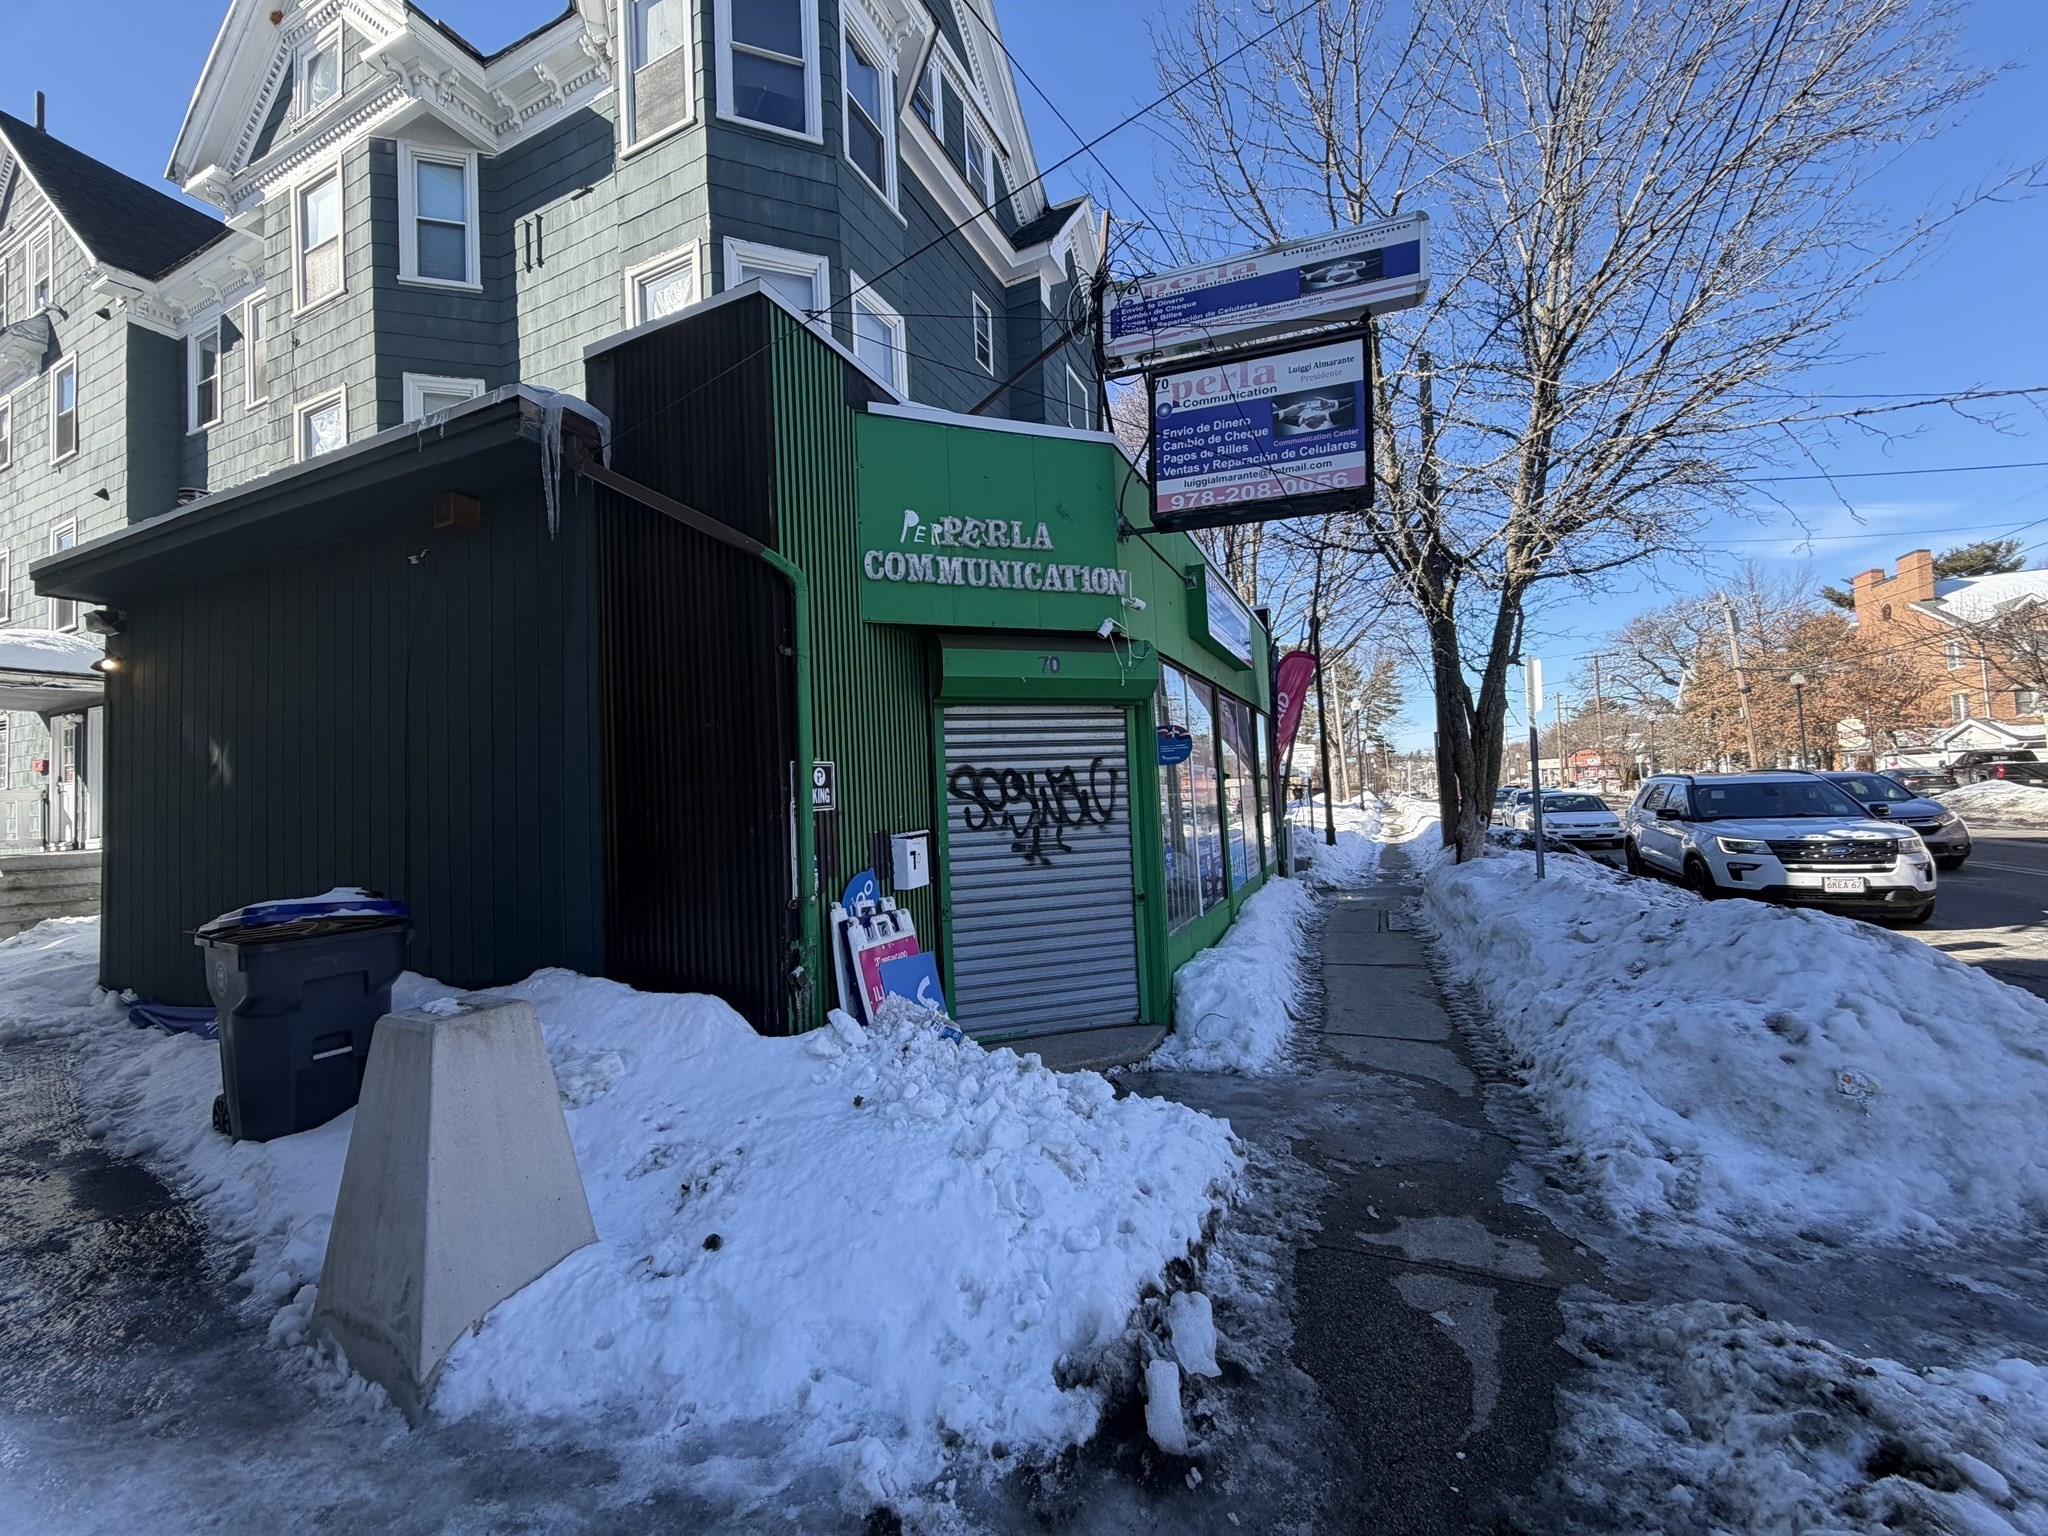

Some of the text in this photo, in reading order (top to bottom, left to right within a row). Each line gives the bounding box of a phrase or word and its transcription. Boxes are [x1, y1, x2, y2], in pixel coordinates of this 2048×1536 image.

[1282, 223, 1411, 258] Luiggi Almarante
[1305, 237, 1386, 259] Presidente
[1143, 261, 1257, 299] perla
[1156, 271, 1259, 298] Communication
[1121, 305, 1144, 315] Envio
[1157, 296, 1185, 307] Dinero
[1153, 307, 1164, 315] de
[1165, 301, 1197, 312] Cheque
[1205, 309, 1216, 318] de
[1217, 302, 1259, 315] Celulares
[1313, 356, 1355, 369] Almarante
[1155, 378, 1169, 391] 70
[1170, 361, 1278, 408] perla
[1300, 369, 1343, 383] Presidente
[1183, 386, 1278, 408] Communication
[1163, 417, 1251, 439] Envio de Dinero
[1273, 428, 1360, 447] Communication Center
[1163, 428, 1269, 452] Cambio de Cheque
[1163, 443, 1249, 464] Pagos de Billes
[1163, 440, 1357, 477] Ventas y Reparación de Celulares
[1184, 460, 1333, 488] luiggialmarante@hotmail.com
[864, 550, 1127, 596] COMMUNICATION
[1037, 655, 1061, 674] 70
[1826, 881, 1861, 889] 6KEA 67
